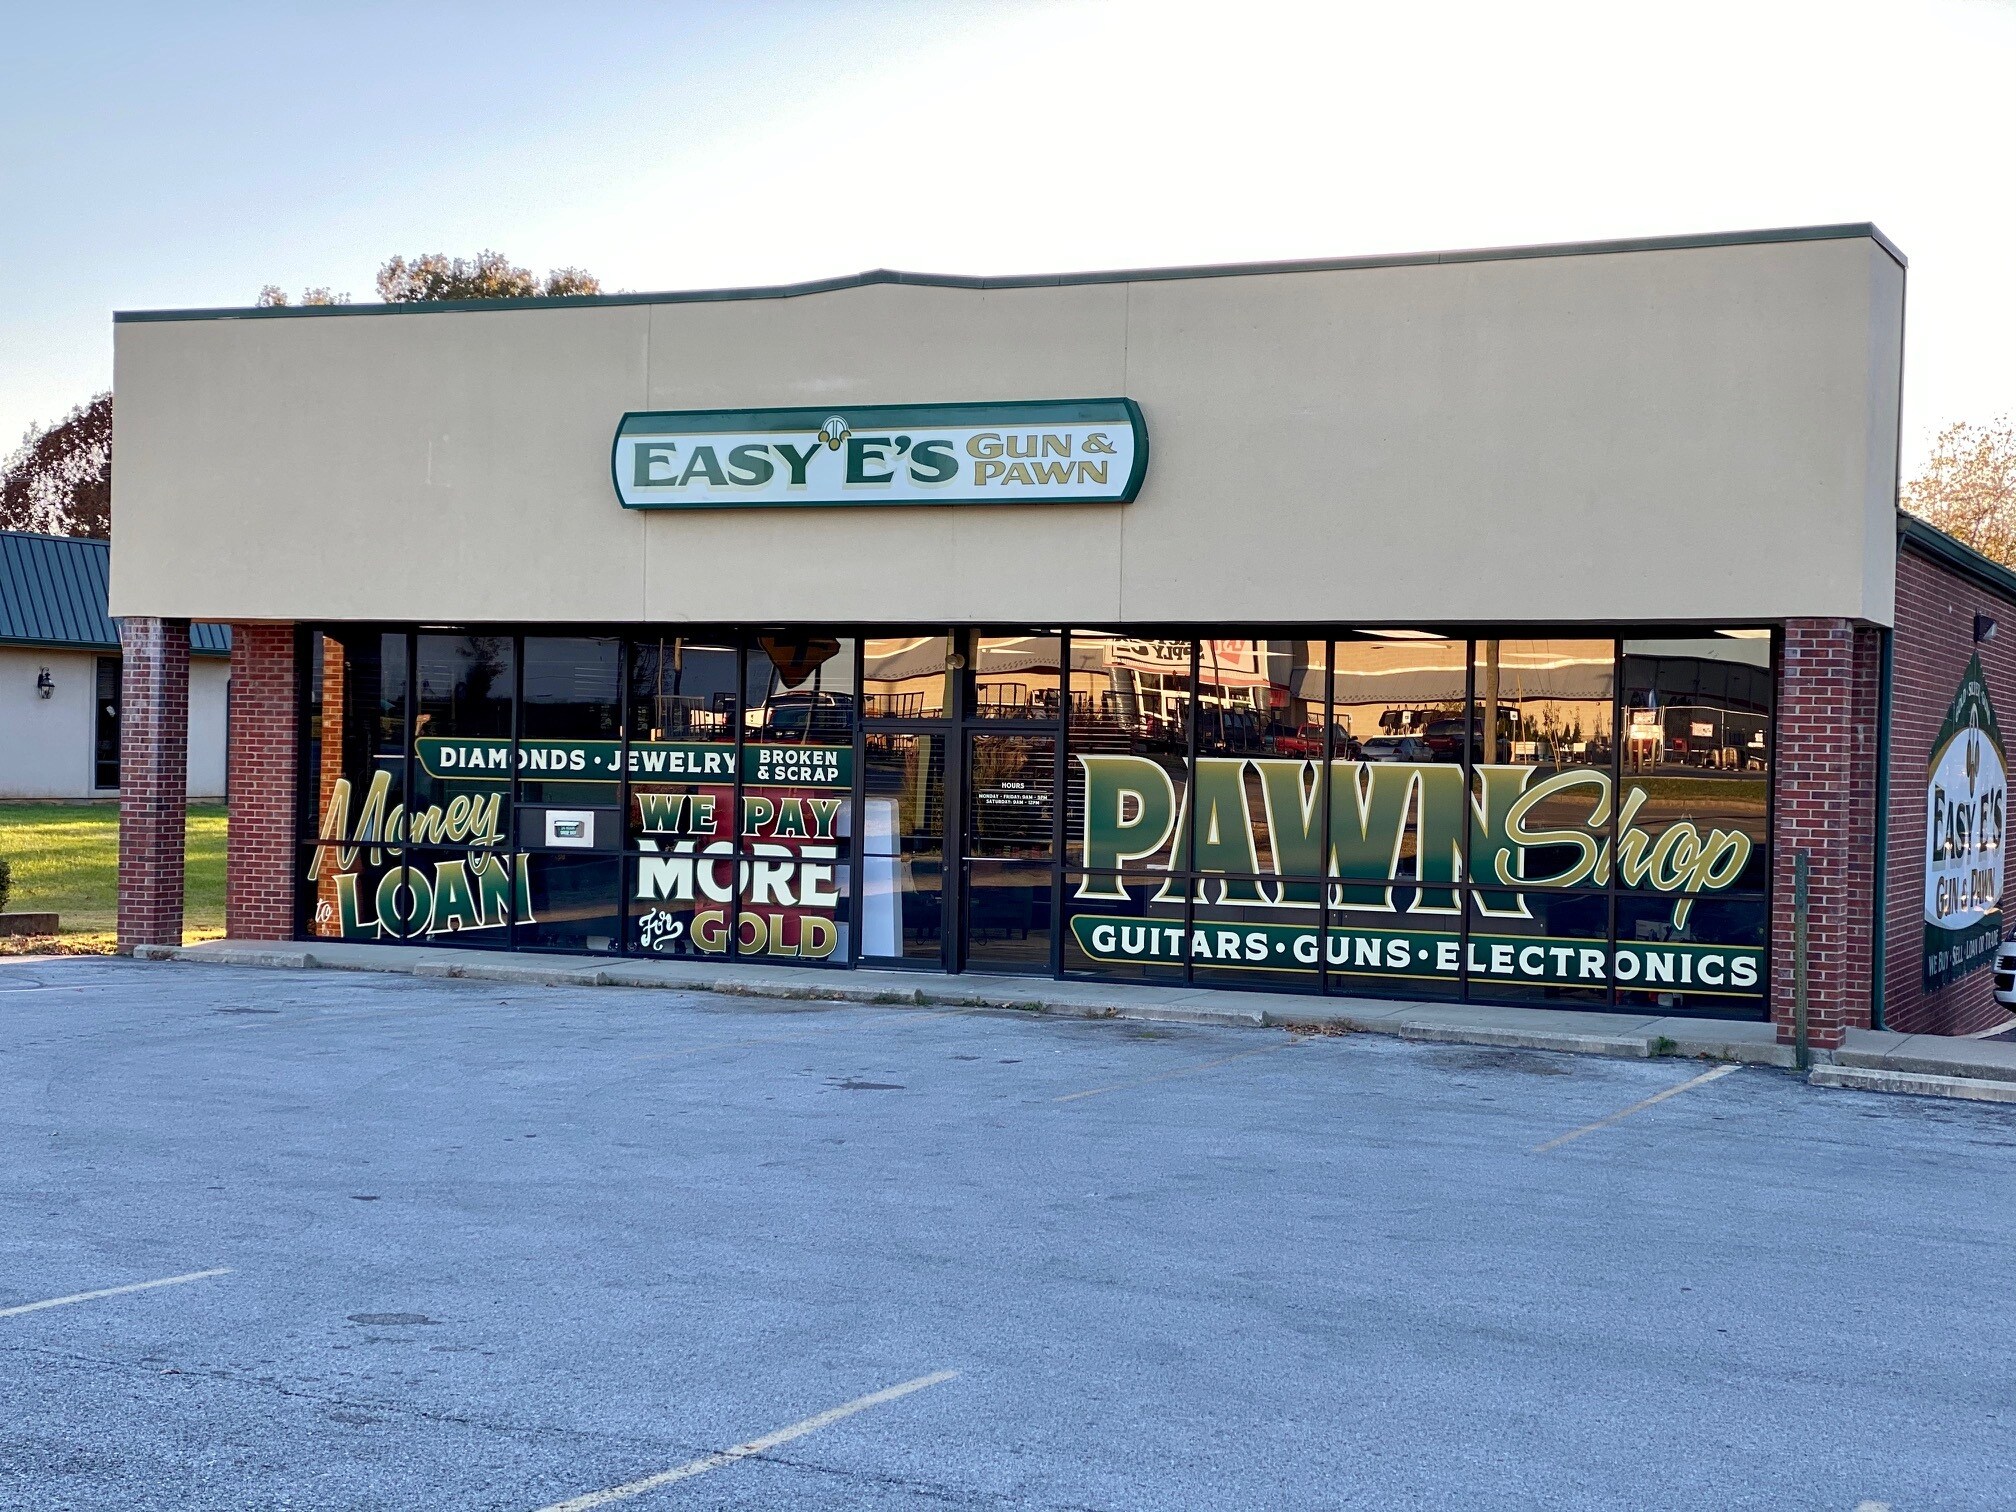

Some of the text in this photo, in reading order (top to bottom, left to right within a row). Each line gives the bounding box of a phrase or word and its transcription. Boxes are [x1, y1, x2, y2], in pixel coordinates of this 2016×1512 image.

[633, 435, 959, 487] EASY E'S
[966, 433, 1117, 459] GUN &
[974, 461, 1107, 486] PAWN
[440, 747, 736, 774] DIAMONDS JEWELRY
[757, 766, 839, 782] & SCRAP
[759, 749, 838, 766] BROKEN
[307, 769, 505, 876] Money
[635, 793, 842, 840] WE PAY
[1074, 754, 1751, 930] PAWN Shop
[1933, 784, 2003, 862] EASY E'S
[315, 853, 537, 940] to LOAN
[636, 838, 841, 908] MORE
[1936, 875, 1959, 920] GUN
[1970, 868, 1996, 908] PAWN
[639, 907, 838, 958] For GOLD
[1092, 925, 1758, 986] GUITARS GUNS ELECTRONICS
[1928, 954, 1938, 977] WE
[1938, 951, 1949, 973] BUY
[1952, 945, 1963, 966] SELL
[1966, 938, 1978, 960] LOAN
[1979, 935, 1985, 954] OR
